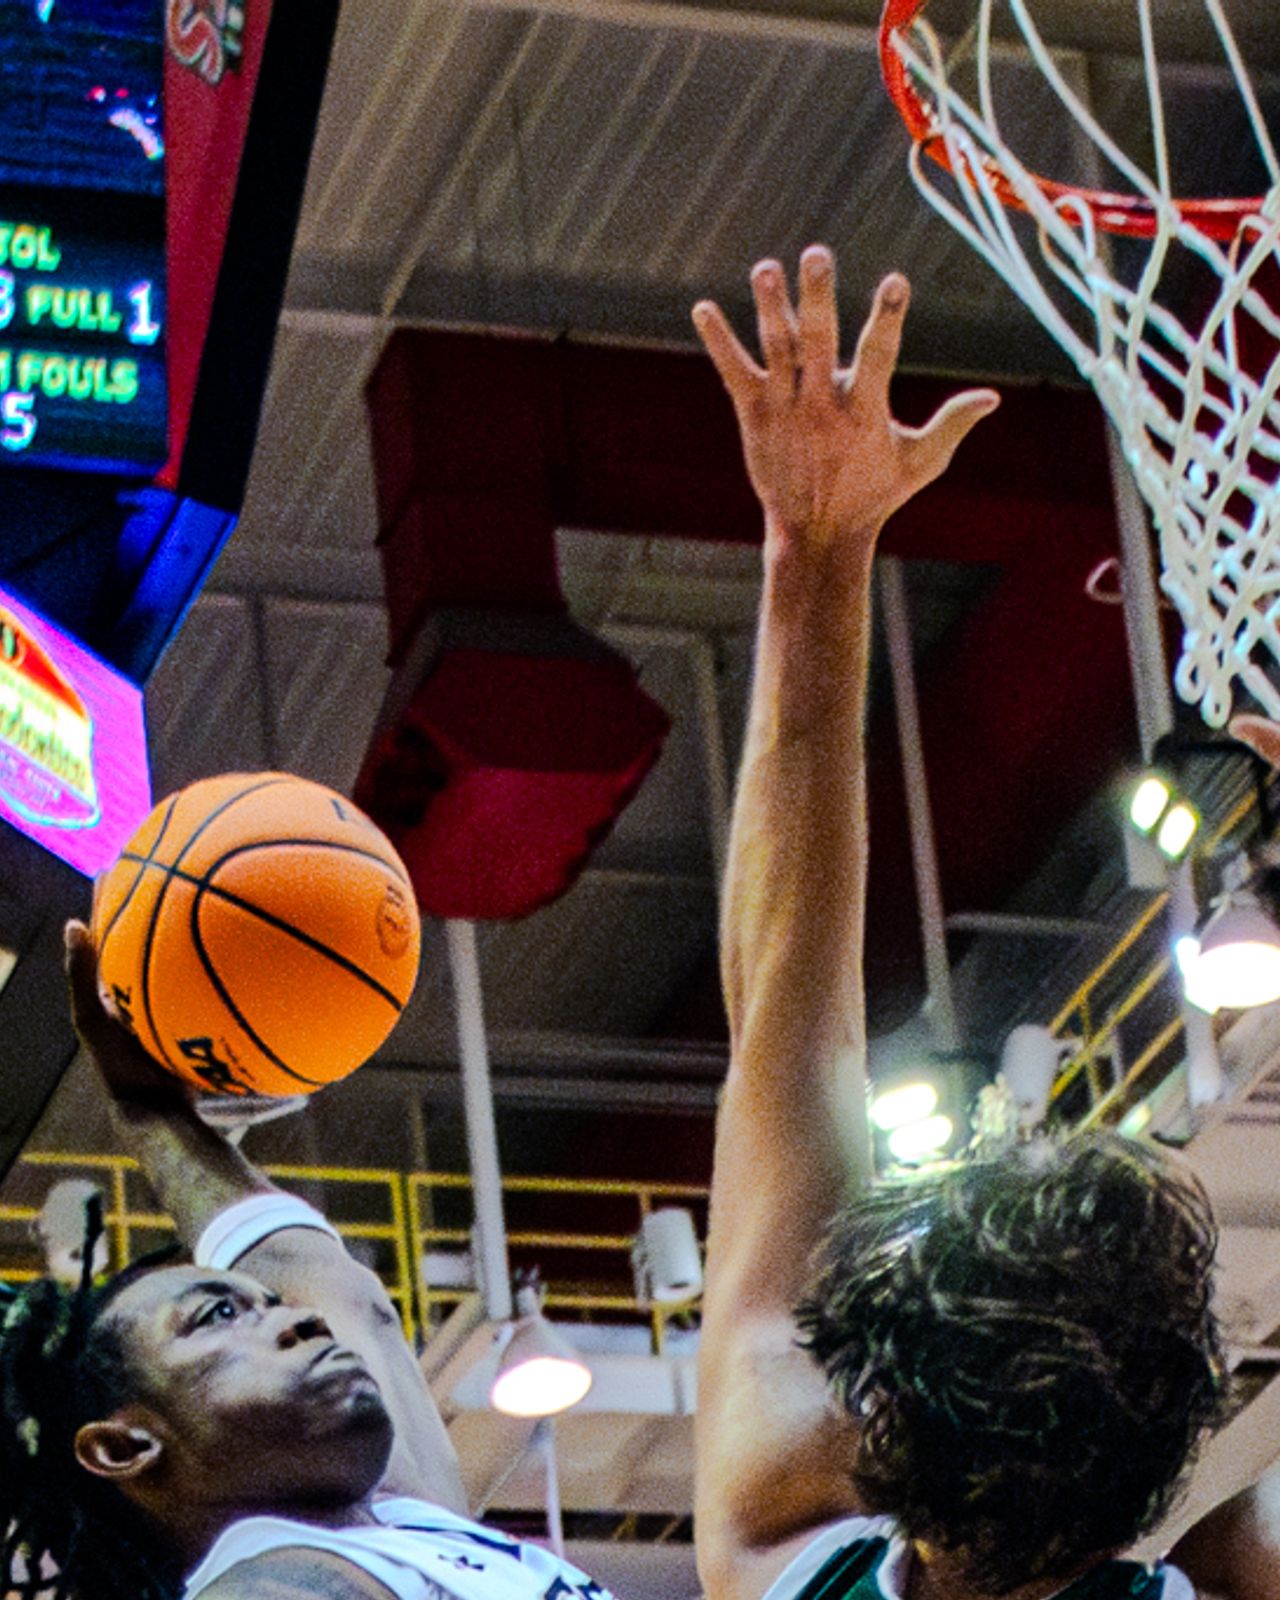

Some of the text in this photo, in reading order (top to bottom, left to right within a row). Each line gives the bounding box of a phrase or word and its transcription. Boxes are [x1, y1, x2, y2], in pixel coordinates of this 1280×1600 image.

[26, 284, 121, 332] FULL
[128, 280, 161, 346] 1
[18, 352, 139, 404] FOULS
[0, 391, 38, 450] 5
